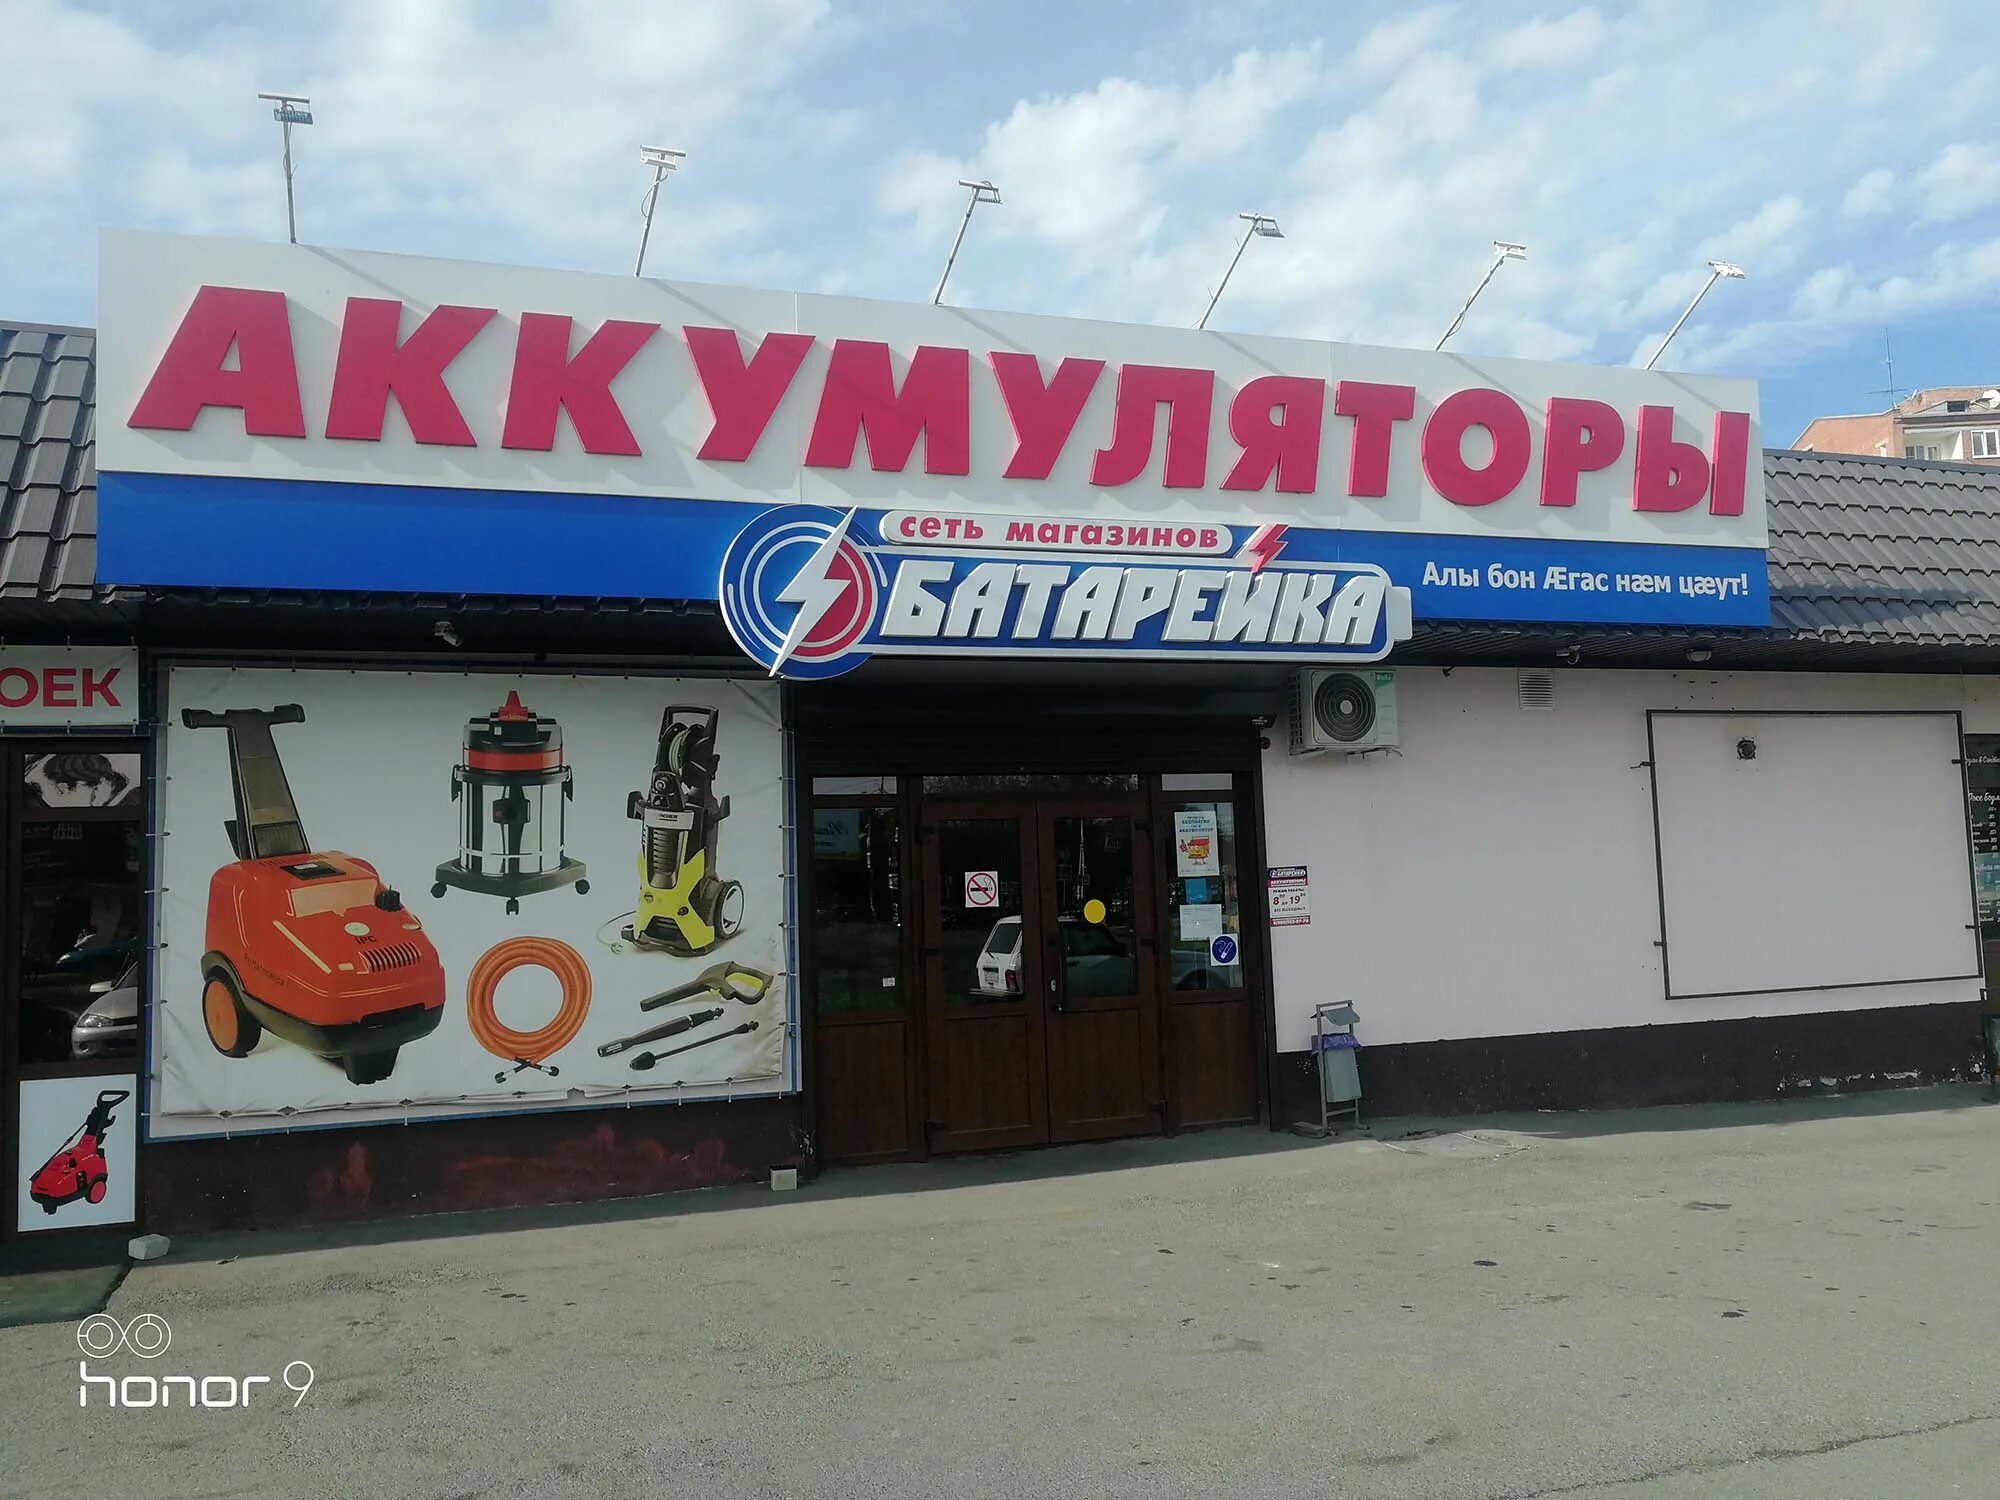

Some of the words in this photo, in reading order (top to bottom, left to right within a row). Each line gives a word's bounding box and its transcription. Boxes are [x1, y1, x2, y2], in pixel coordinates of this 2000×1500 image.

[131, 286, 1749, 516] АККУМУЛЯТОРЫ
[900, 516, 983, 539] сеть
[1005, 522, 1218, 549] магазинов
[880, 525, 1386, 646] БАТАРЕЙКА
[1422, 561, 1480, 588] Алы
[1487, 563, 1537, 590] бон
[355, 935, 377, 945] IPC
